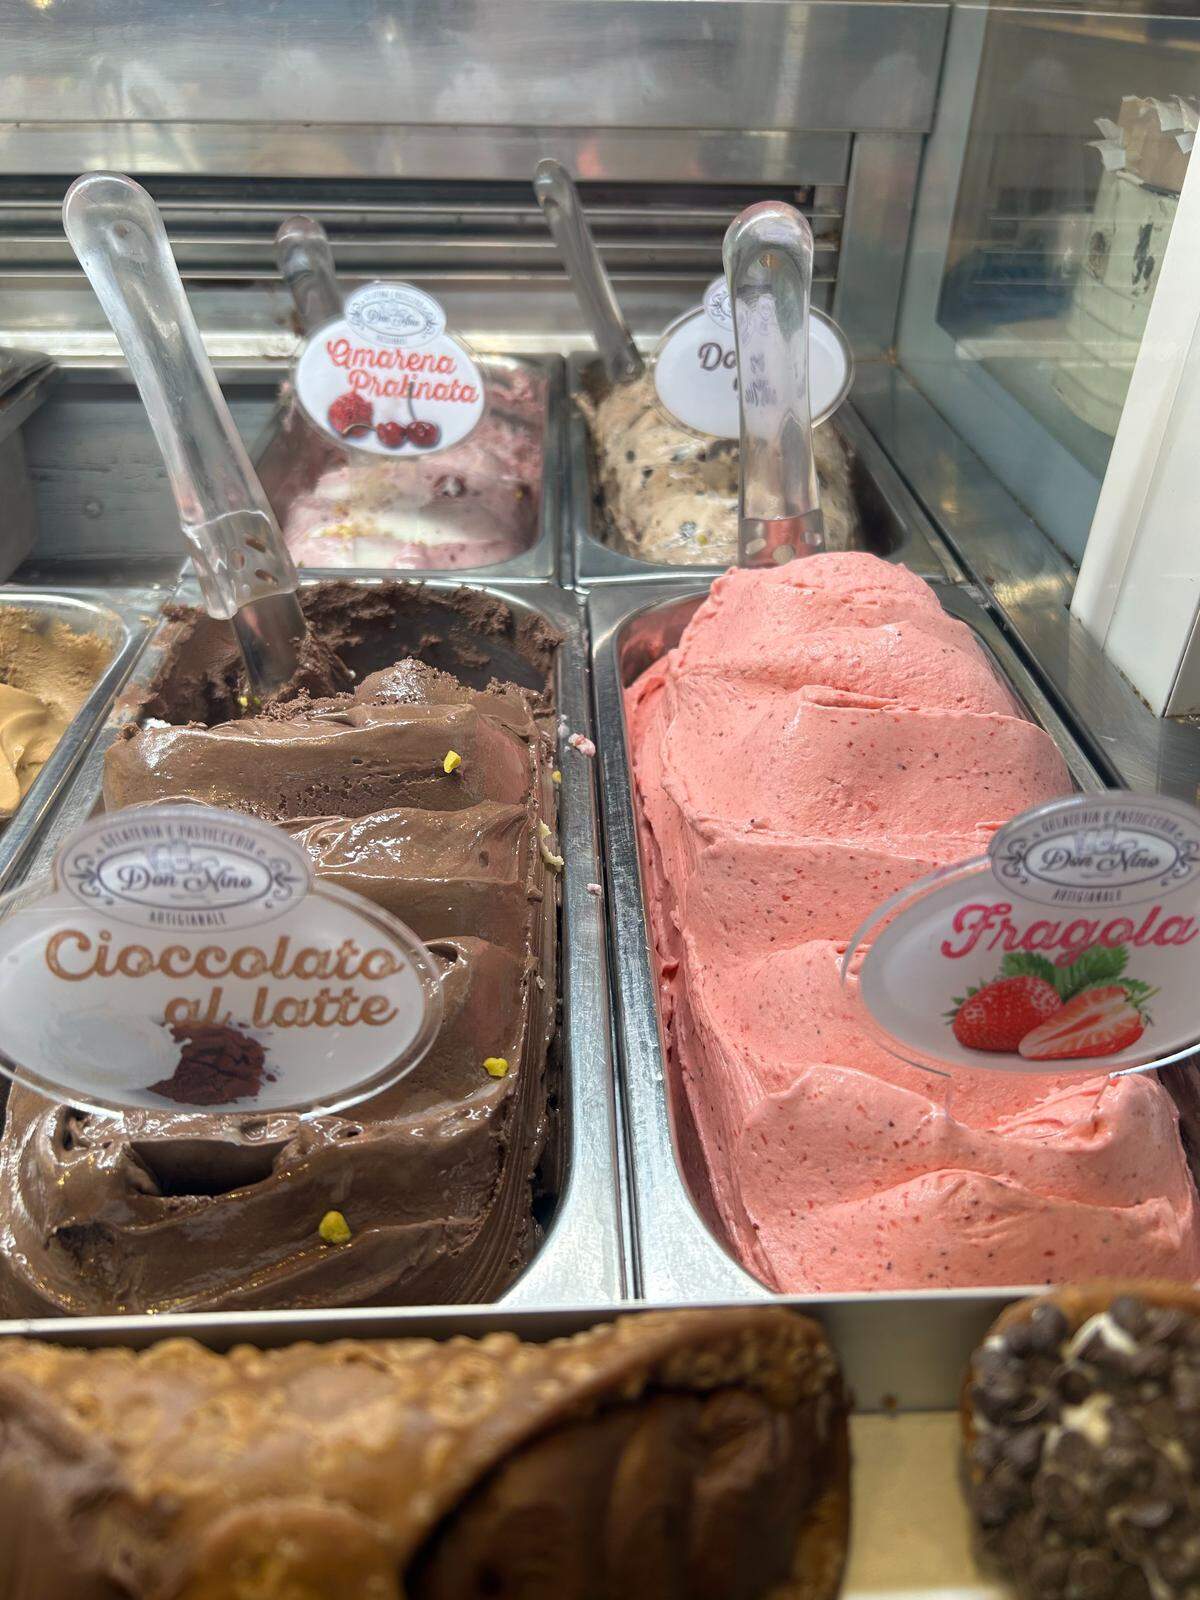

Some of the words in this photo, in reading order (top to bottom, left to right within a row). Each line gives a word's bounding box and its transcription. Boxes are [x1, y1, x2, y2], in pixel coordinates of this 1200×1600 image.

[327, 338, 457, 375] Amarena
[349, 369, 480, 404] Pralinata
[1038, 847, 1092, 872] Don
[1095, 838, 1160, 872] Nino
[116, 864, 178, 893] Don
[183, 857, 254, 893] Nino
[940, 903, 1199, 968] Fragola
[45, 929, 404, 982] Cioccolato
[163, 987, 232, 1028] al
[251, 987, 399, 1029] latte
